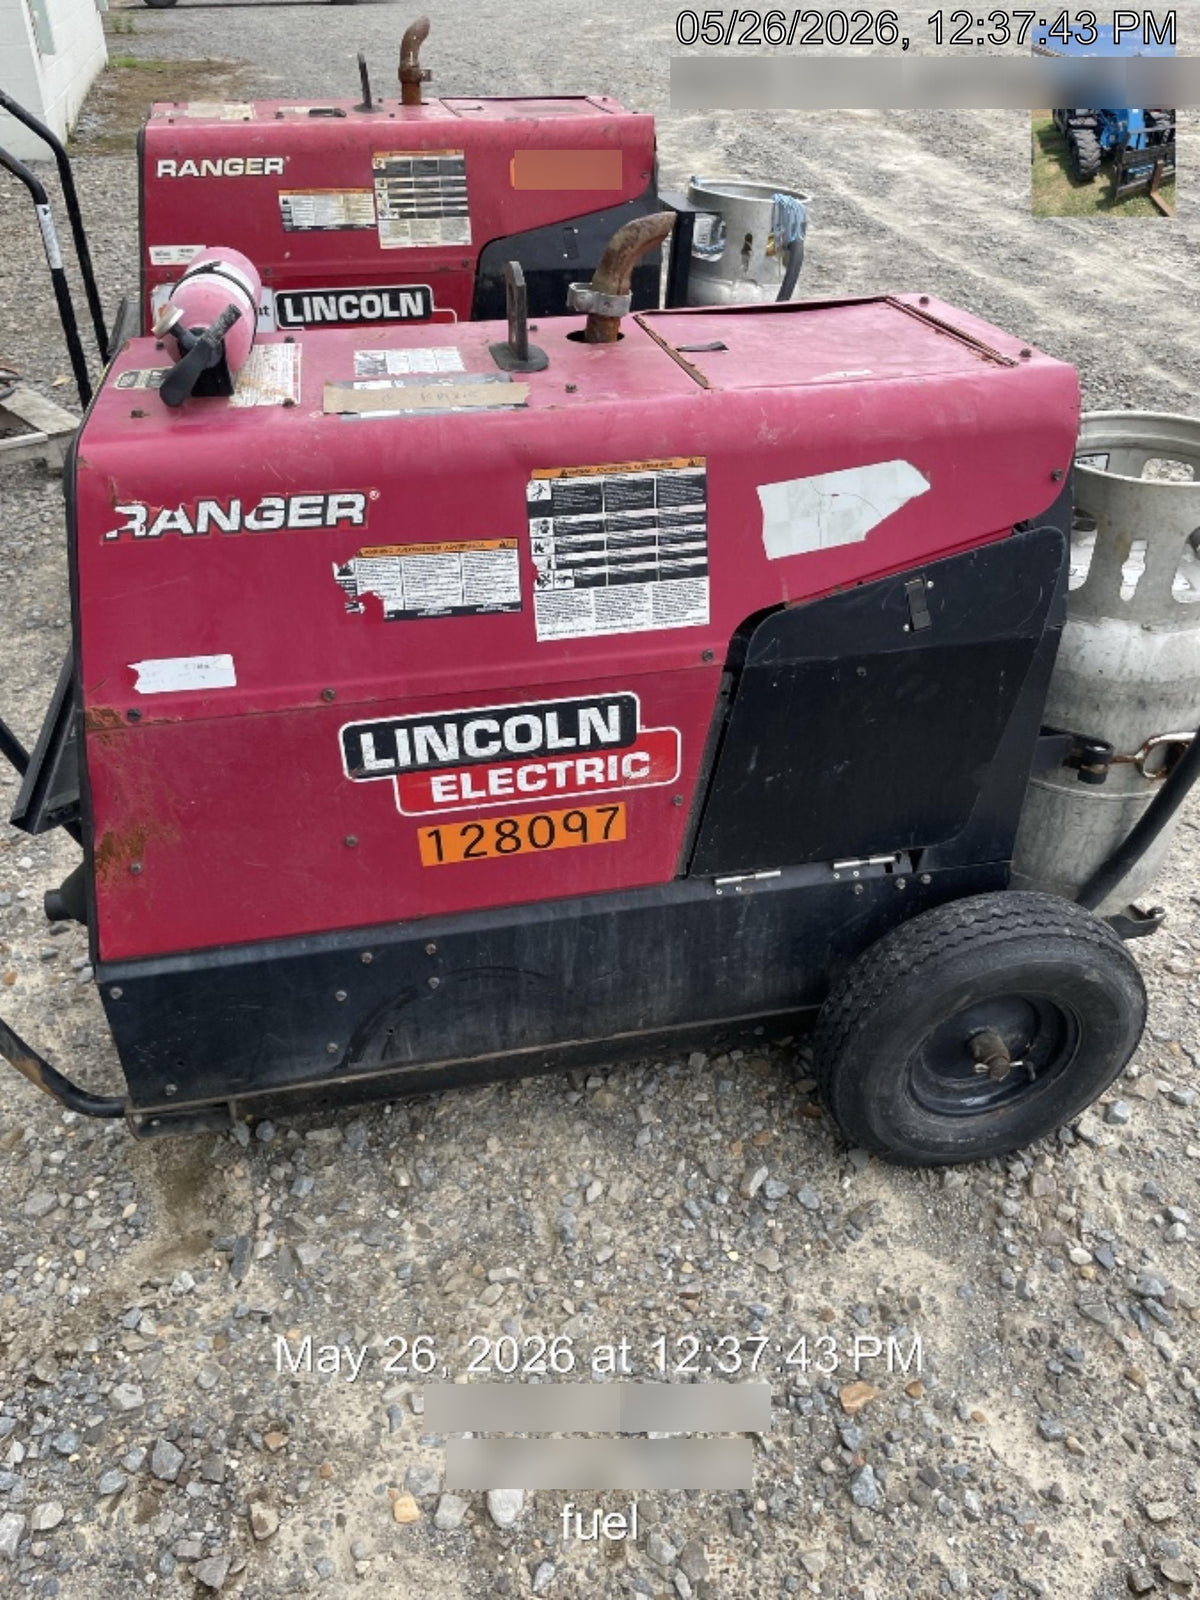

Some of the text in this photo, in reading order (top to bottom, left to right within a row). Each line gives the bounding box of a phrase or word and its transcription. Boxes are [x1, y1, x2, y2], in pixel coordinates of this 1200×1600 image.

[156, 156, 285, 179] RANGER
[283, 291, 424, 324] LINCOLN
[103, 492, 367, 540] RANGER
[359, 704, 622, 771] LINCOLN
[430, 751, 651, 804] ELECTRIC
[426, 805, 620, 862] 128097
